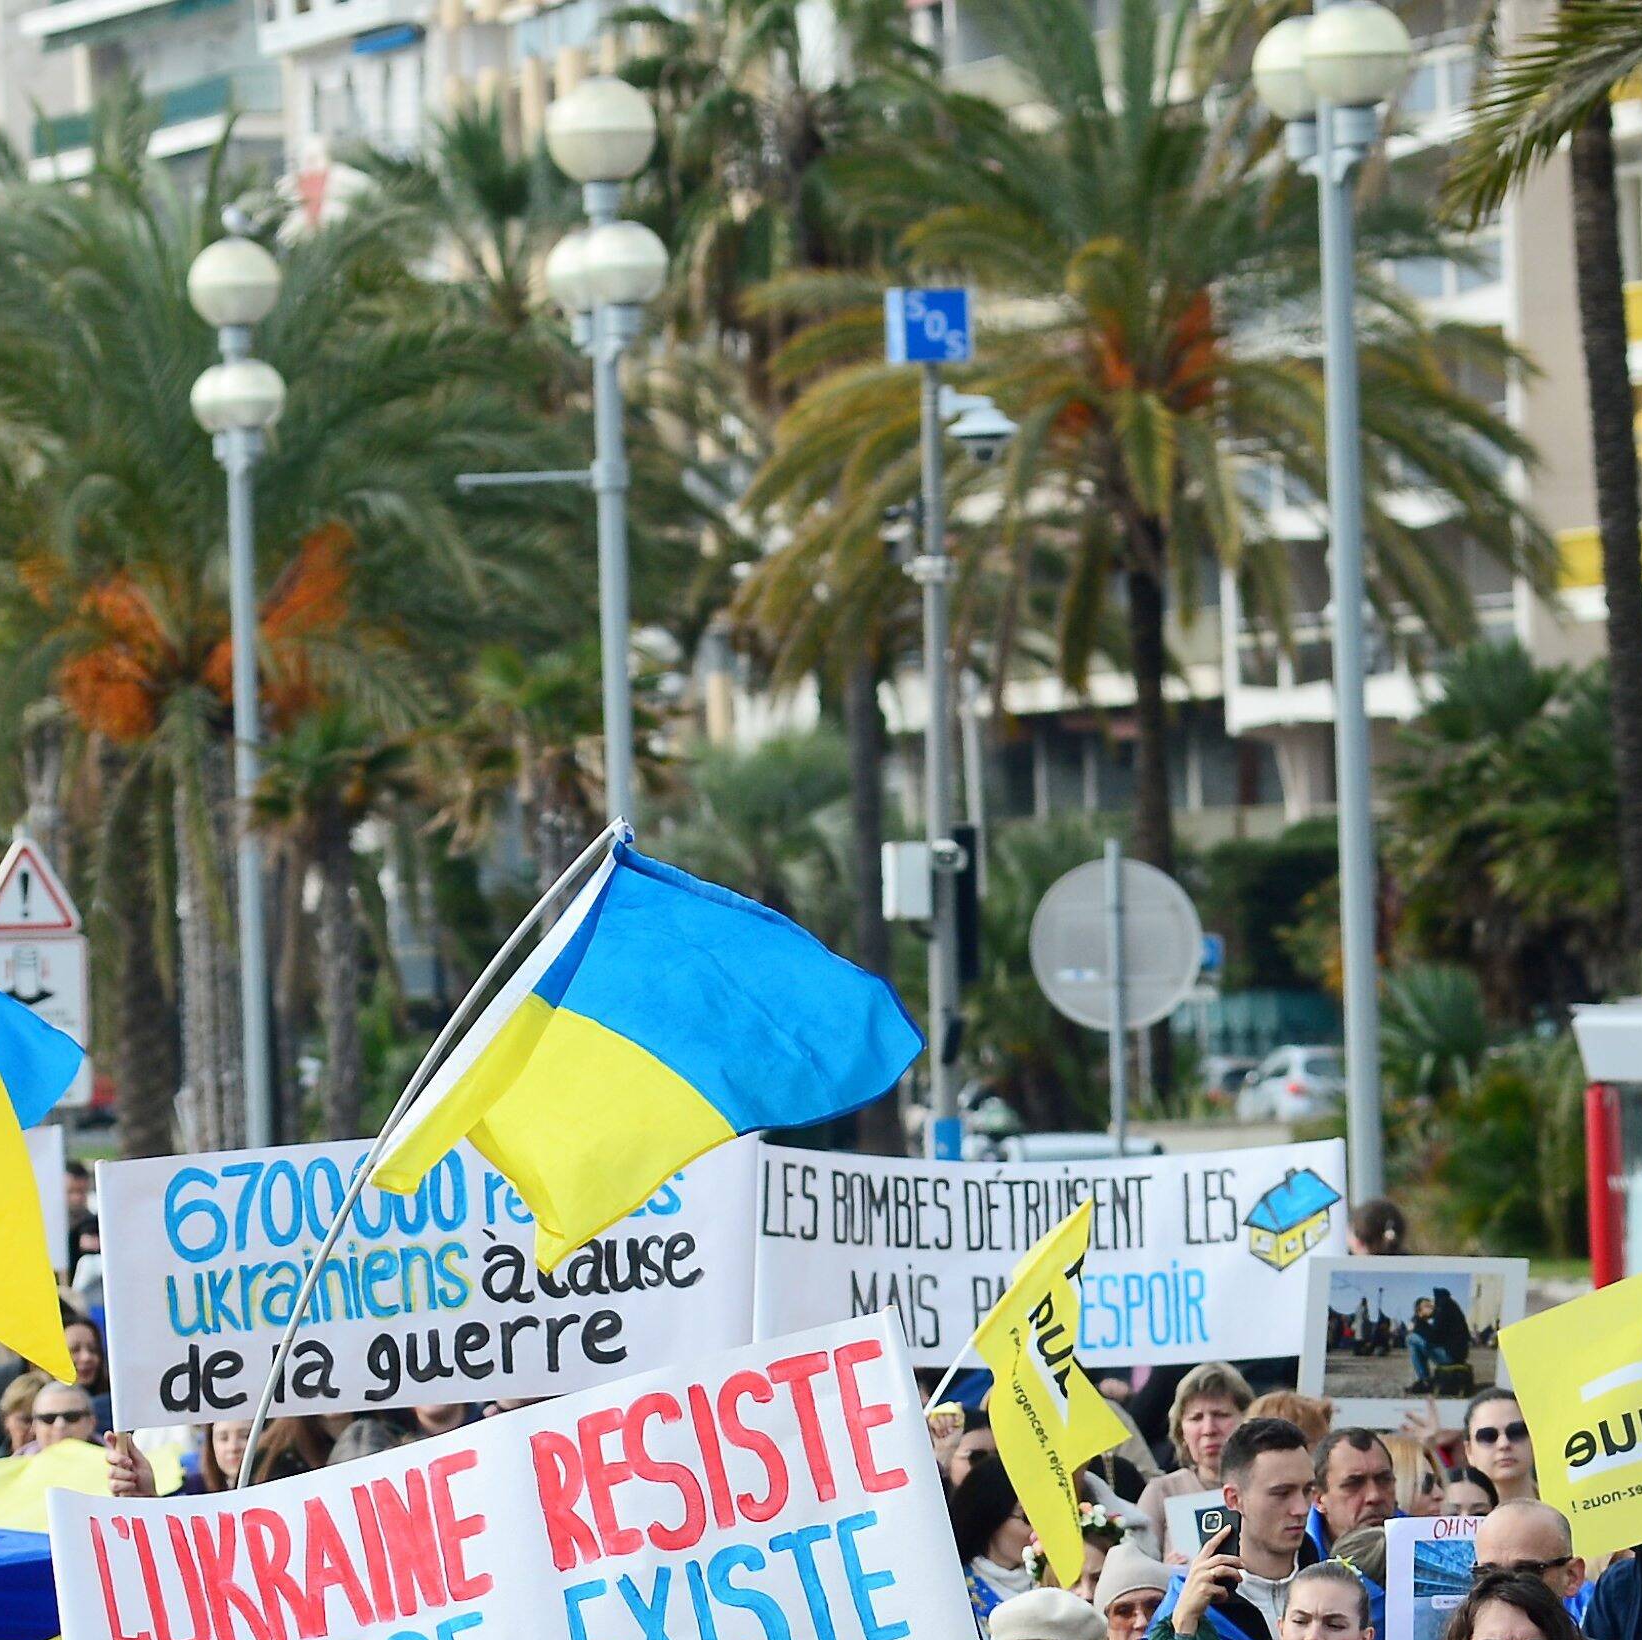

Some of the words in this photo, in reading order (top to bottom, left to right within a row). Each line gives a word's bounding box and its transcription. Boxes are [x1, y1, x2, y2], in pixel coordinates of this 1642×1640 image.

[906, 289, 965, 360] SOS
[762, 1160, 819, 1241] LES
[831, 1169, 953, 1251] BOMBES
[1183, 1168, 1238, 1245] LES
[165, 1238, 470, 1337] ukrainiens
[482, 1229, 535, 1303] à
[160, 1344, 248, 1412] de
[271, 1339, 341, 1402] la
[364, 1309, 628, 1400] guerre
[530, 1339, 910, 1573] RESISTE
